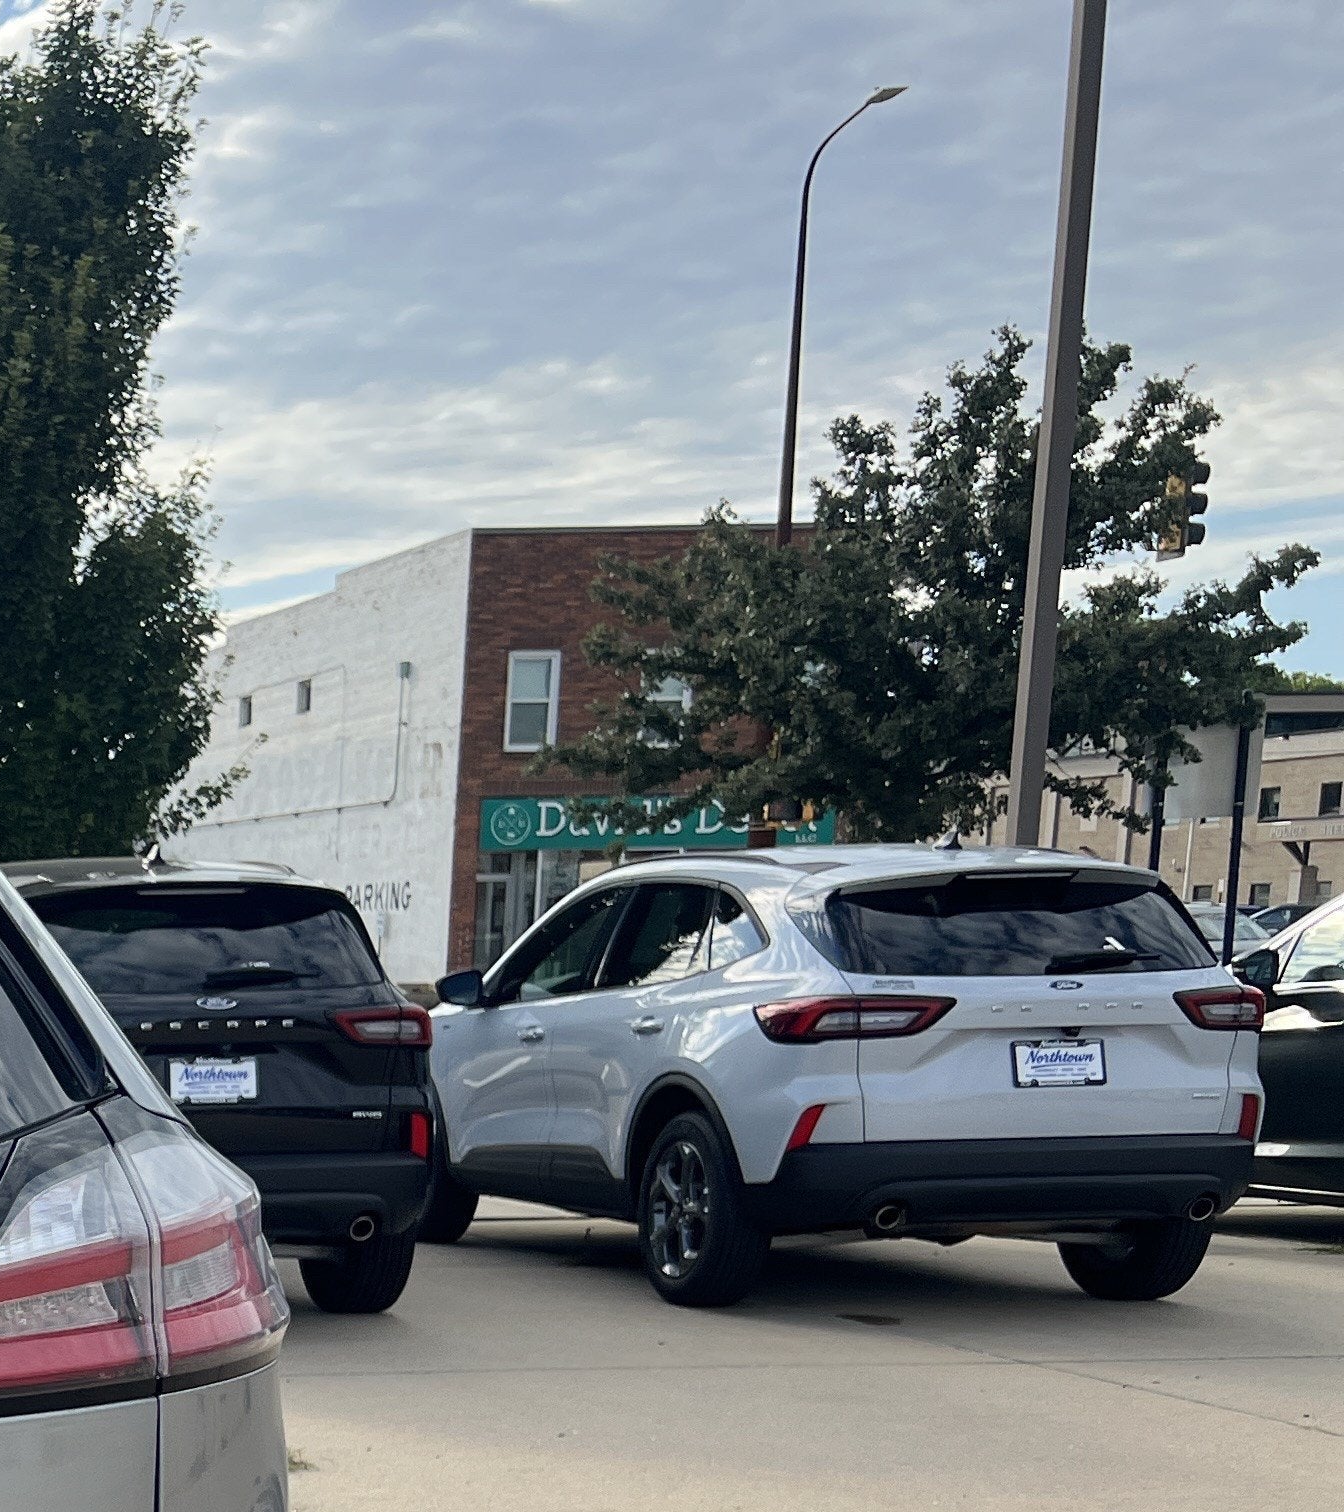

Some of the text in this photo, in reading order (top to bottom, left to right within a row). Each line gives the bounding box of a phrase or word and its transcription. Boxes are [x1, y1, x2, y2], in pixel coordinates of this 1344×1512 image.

[535, 800, 683, 837] Dav's
[346, 881, 411, 911] PARKING
[1025, 1050, 1095, 1065] Northtown
